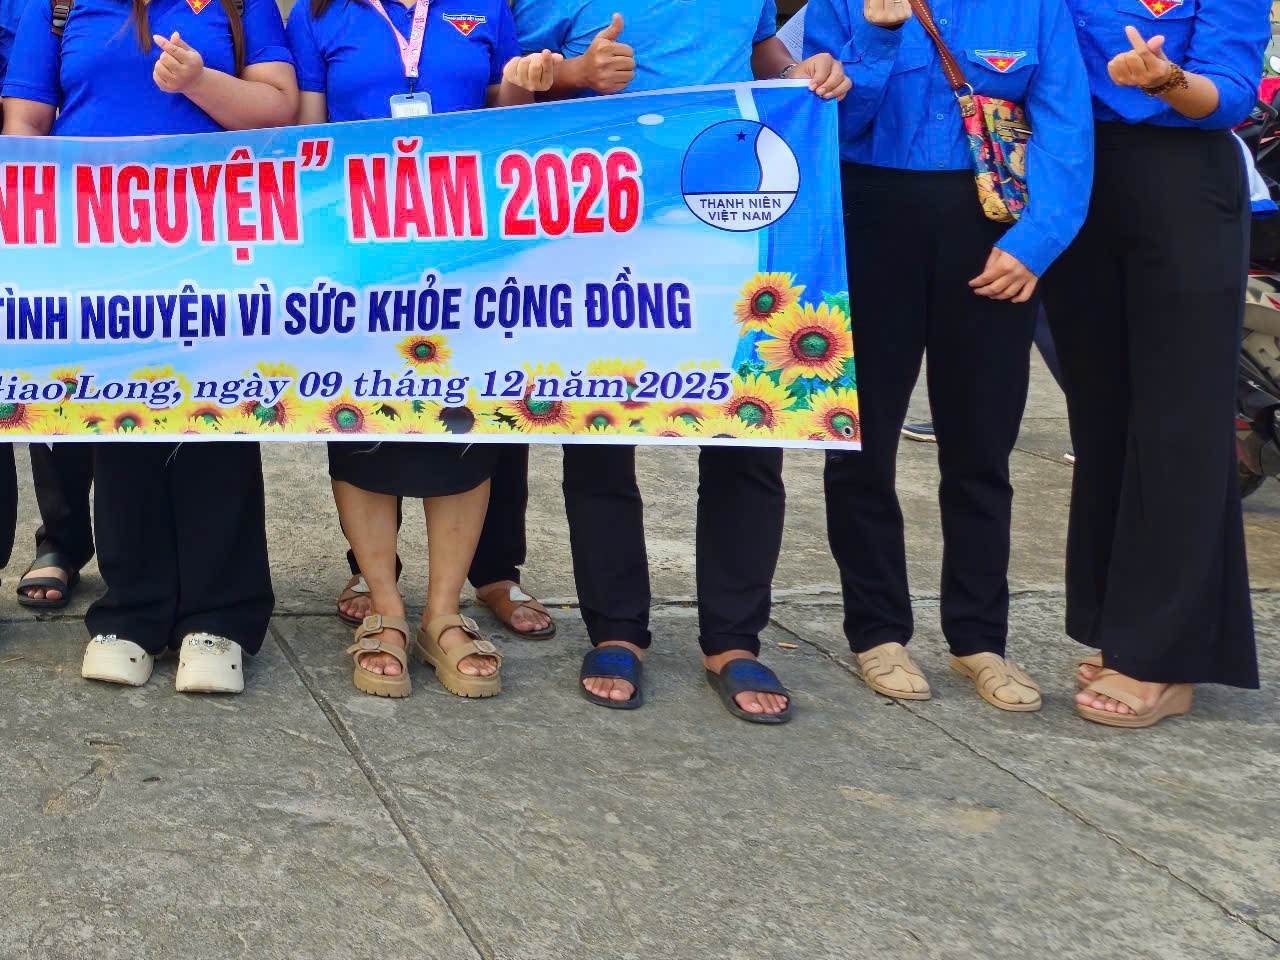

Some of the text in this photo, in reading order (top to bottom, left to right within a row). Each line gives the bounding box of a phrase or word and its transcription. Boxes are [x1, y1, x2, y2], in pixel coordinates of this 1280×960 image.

[347, 138, 484, 240] NĂM
[499, 150, 641, 236] 2026
[699, 195, 781, 209] THANH NIÊN
[708, 209, 772, 222] VIỆT NAM
[80, 284, 226, 347] NGUYỆN
[238, 283, 271, 337] VÌ
[284, 282, 356, 336] SỨC
[368, 273, 462, 333] KHỎE
[474, 276, 573, 339] CỘNG
[584, 266, 692, 330] ĐỒNG
[73, 375, 182, 405] Long,
[193, 372, 291, 406] ngày
[299, 371, 343, 398] 09
[353, 370, 470, 402] tháng
[480, 370, 525, 398] 12
[534, 369, 626, 399] năm
[634, 371, 732, 400] 2025
